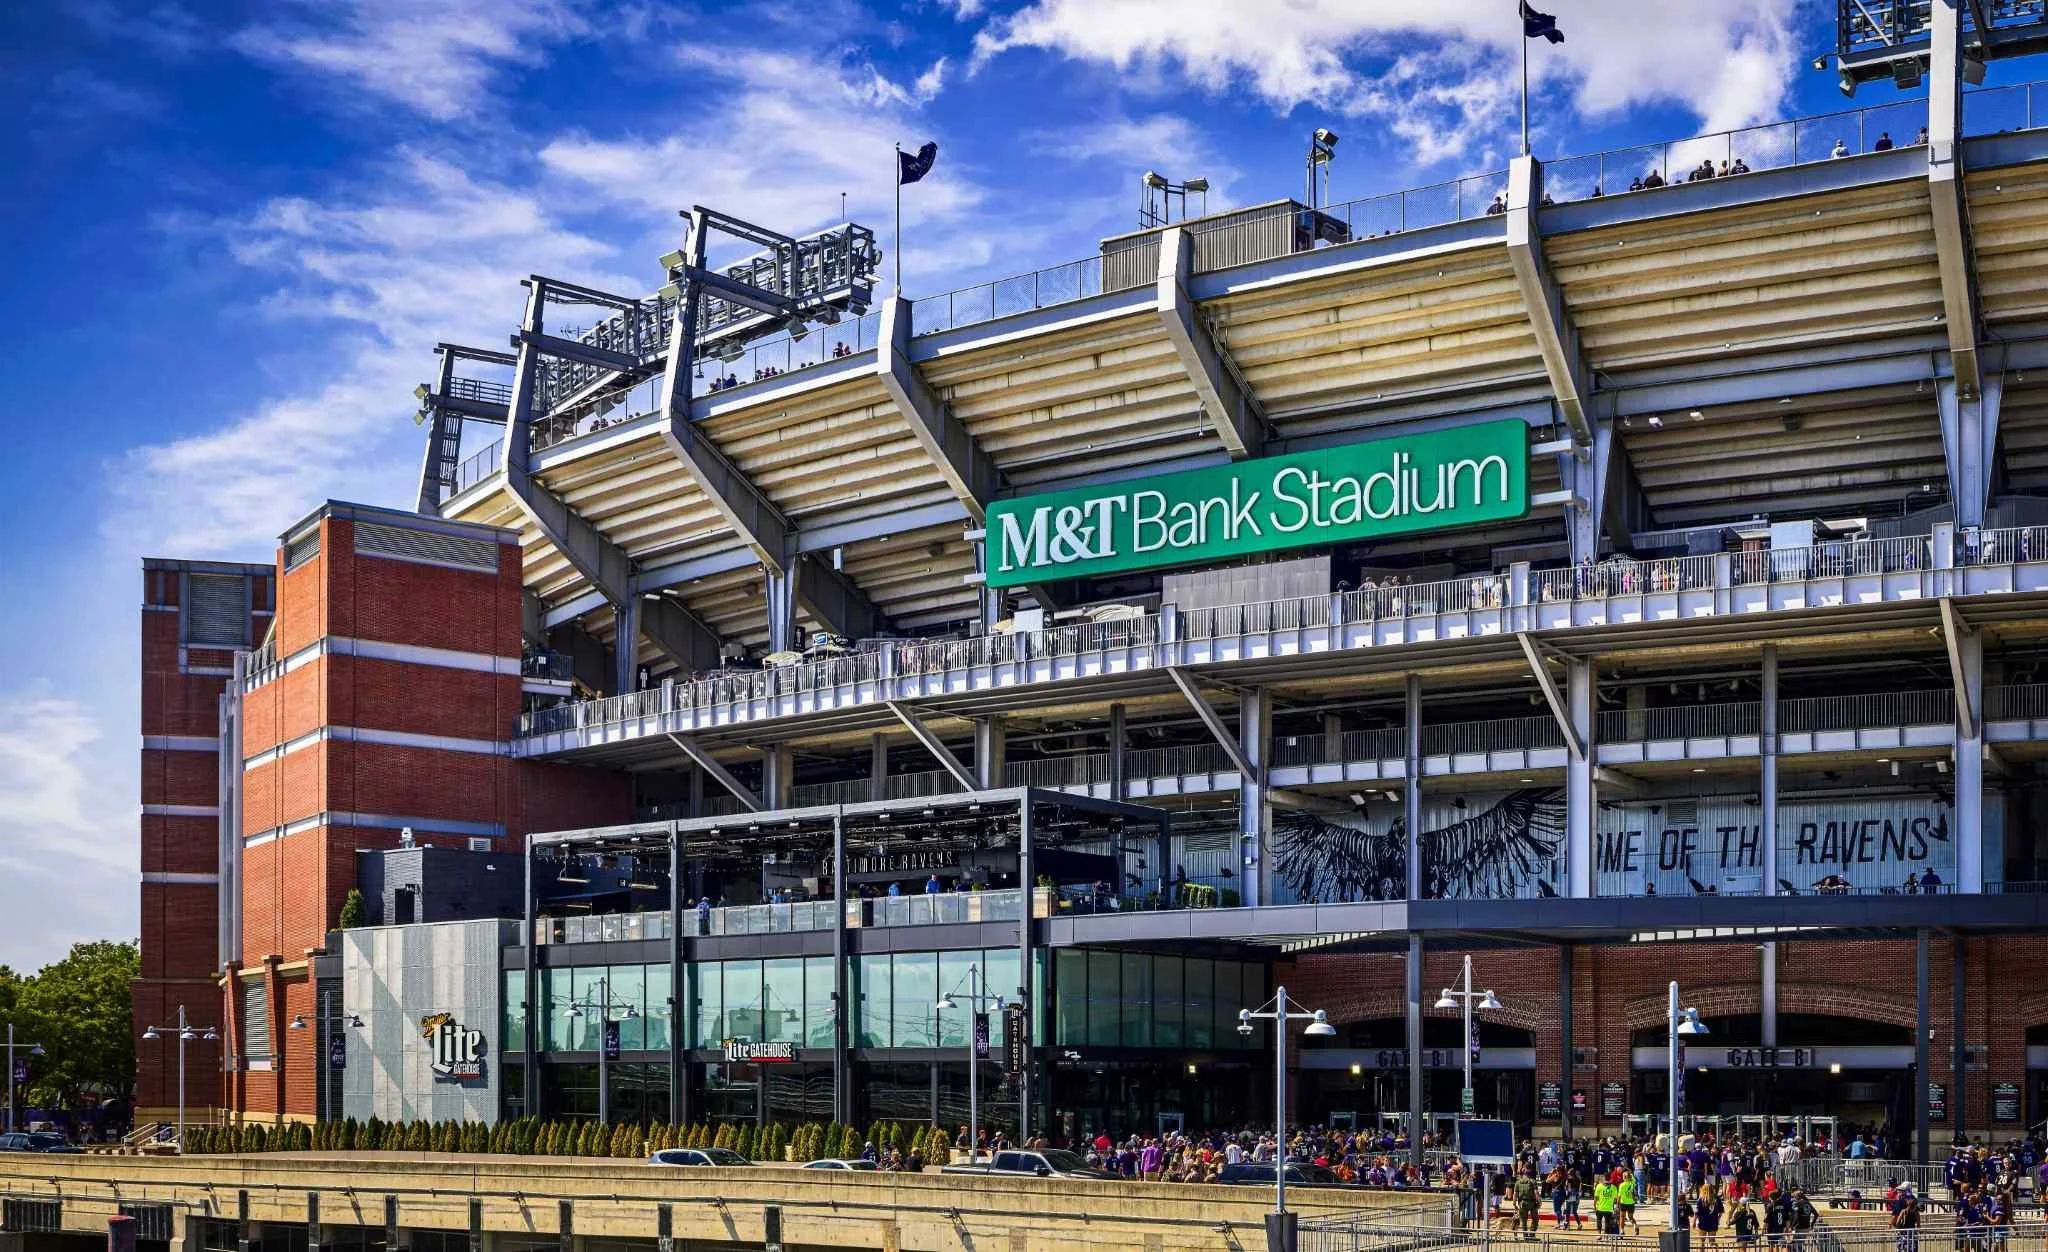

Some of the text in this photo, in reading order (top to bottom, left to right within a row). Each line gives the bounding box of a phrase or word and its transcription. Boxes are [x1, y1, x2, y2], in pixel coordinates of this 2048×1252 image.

[998, 452, 1508, 571] M&T Bank Stadium
[1659, 828, 1697, 870] OF
[1717, 825, 1764, 869] TH
[1797, 817, 1931, 865] RAVENS
[902, 851, 952, 870] RAVENS
[431, 1025, 481, 1074] Lite
[728, 1042, 749, 1061] Lite
[750, 1042, 792, 1057] GATEHOUSE
[1379, 1050, 1410, 1067] GAT
[1795, 1049, 1804, 1067] B
